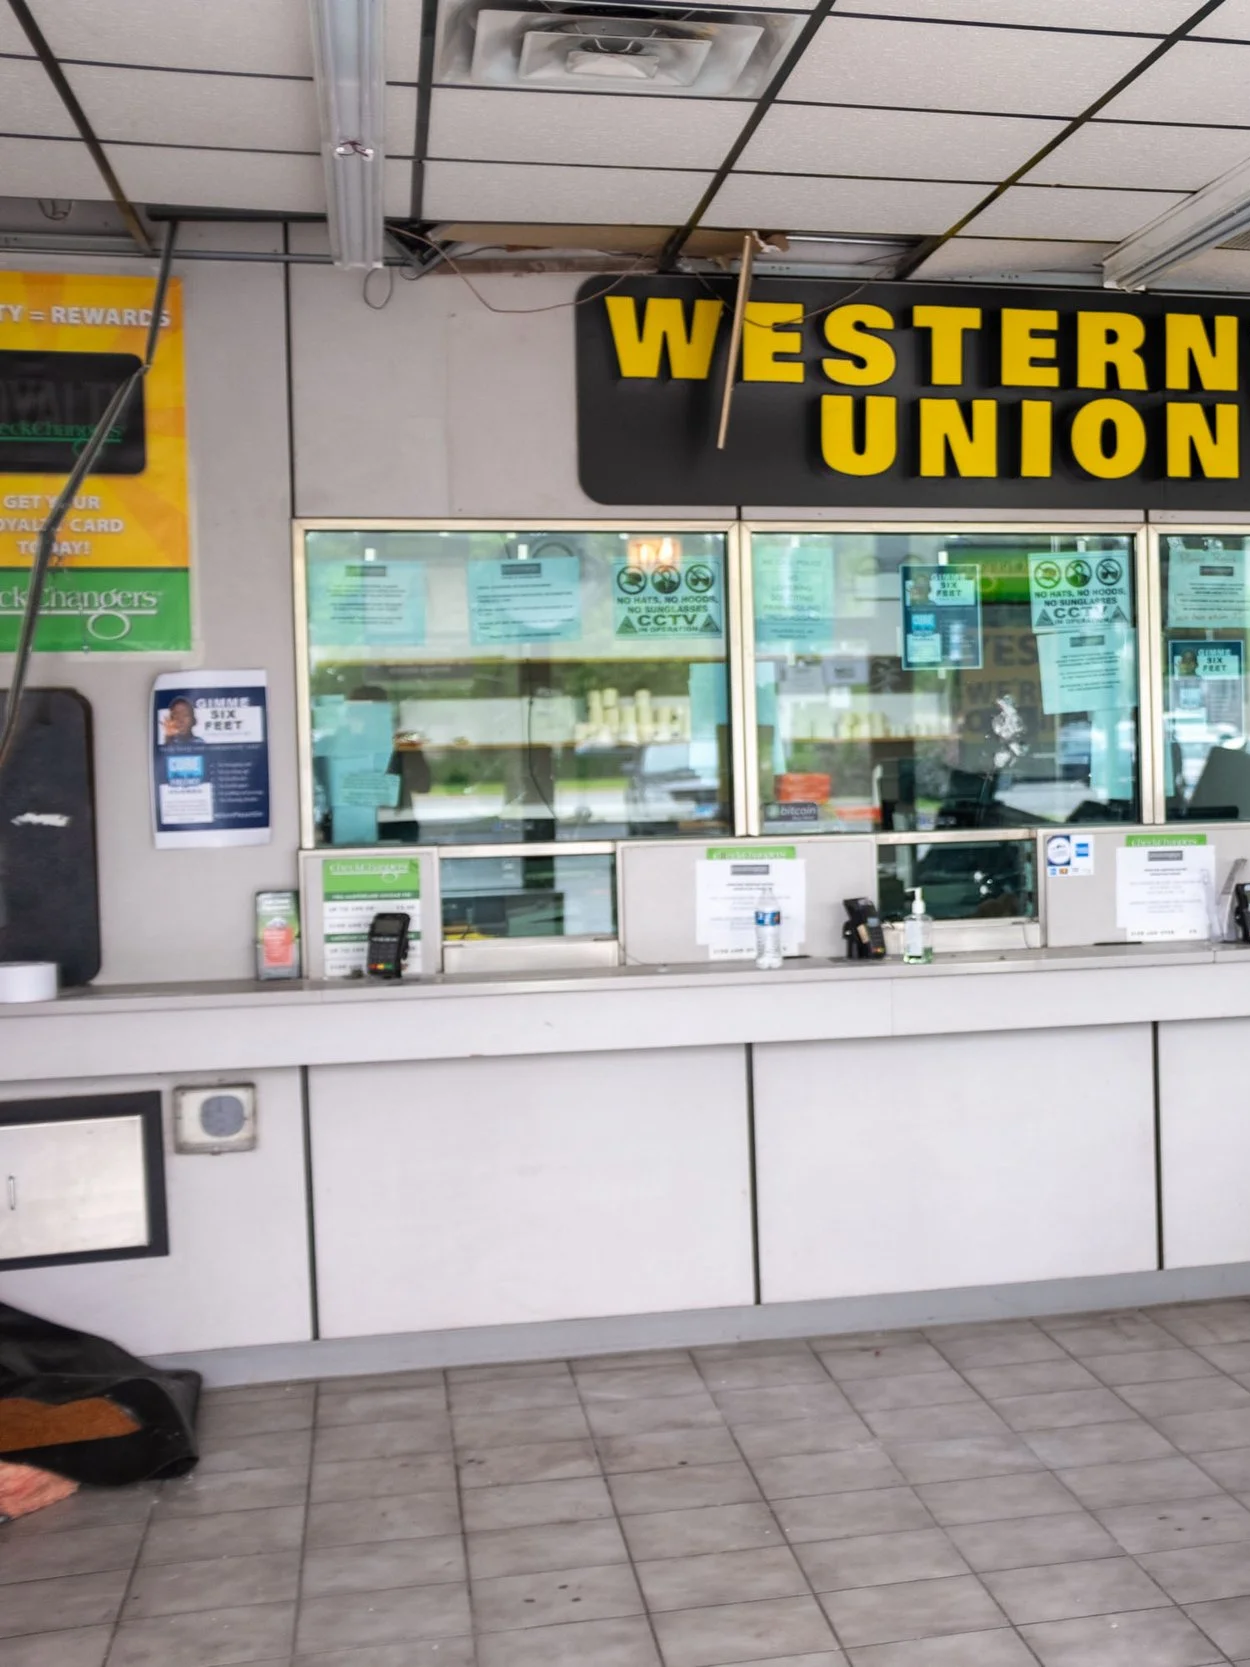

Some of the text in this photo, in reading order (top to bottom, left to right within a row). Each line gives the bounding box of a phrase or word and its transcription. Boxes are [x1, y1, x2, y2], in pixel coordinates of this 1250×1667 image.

[51, 306, 171, 327] REWARDS
[604, 296, 1239, 391] WESTERN
[820, 394, 1239, 479] UNION
[4, 495, 100, 510] GET YUR
[69, 519, 124, 533] CARD
[17, 541, 90, 555] TOAY!
[616, 596, 631, 604] NO
[1058, 597, 1117, 606] SUNGLASSES
[645, 604, 708, 613] SUNGLASSES
[1053, 606, 1107, 618] CCT
[637, 614, 697, 626] CCTV
[195, 697, 251, 708] GIMME
[209, 709, 238, 719] SIX
[204, 720, 246, 731] FEET
[780, 805, 816, 815] bitcoin
